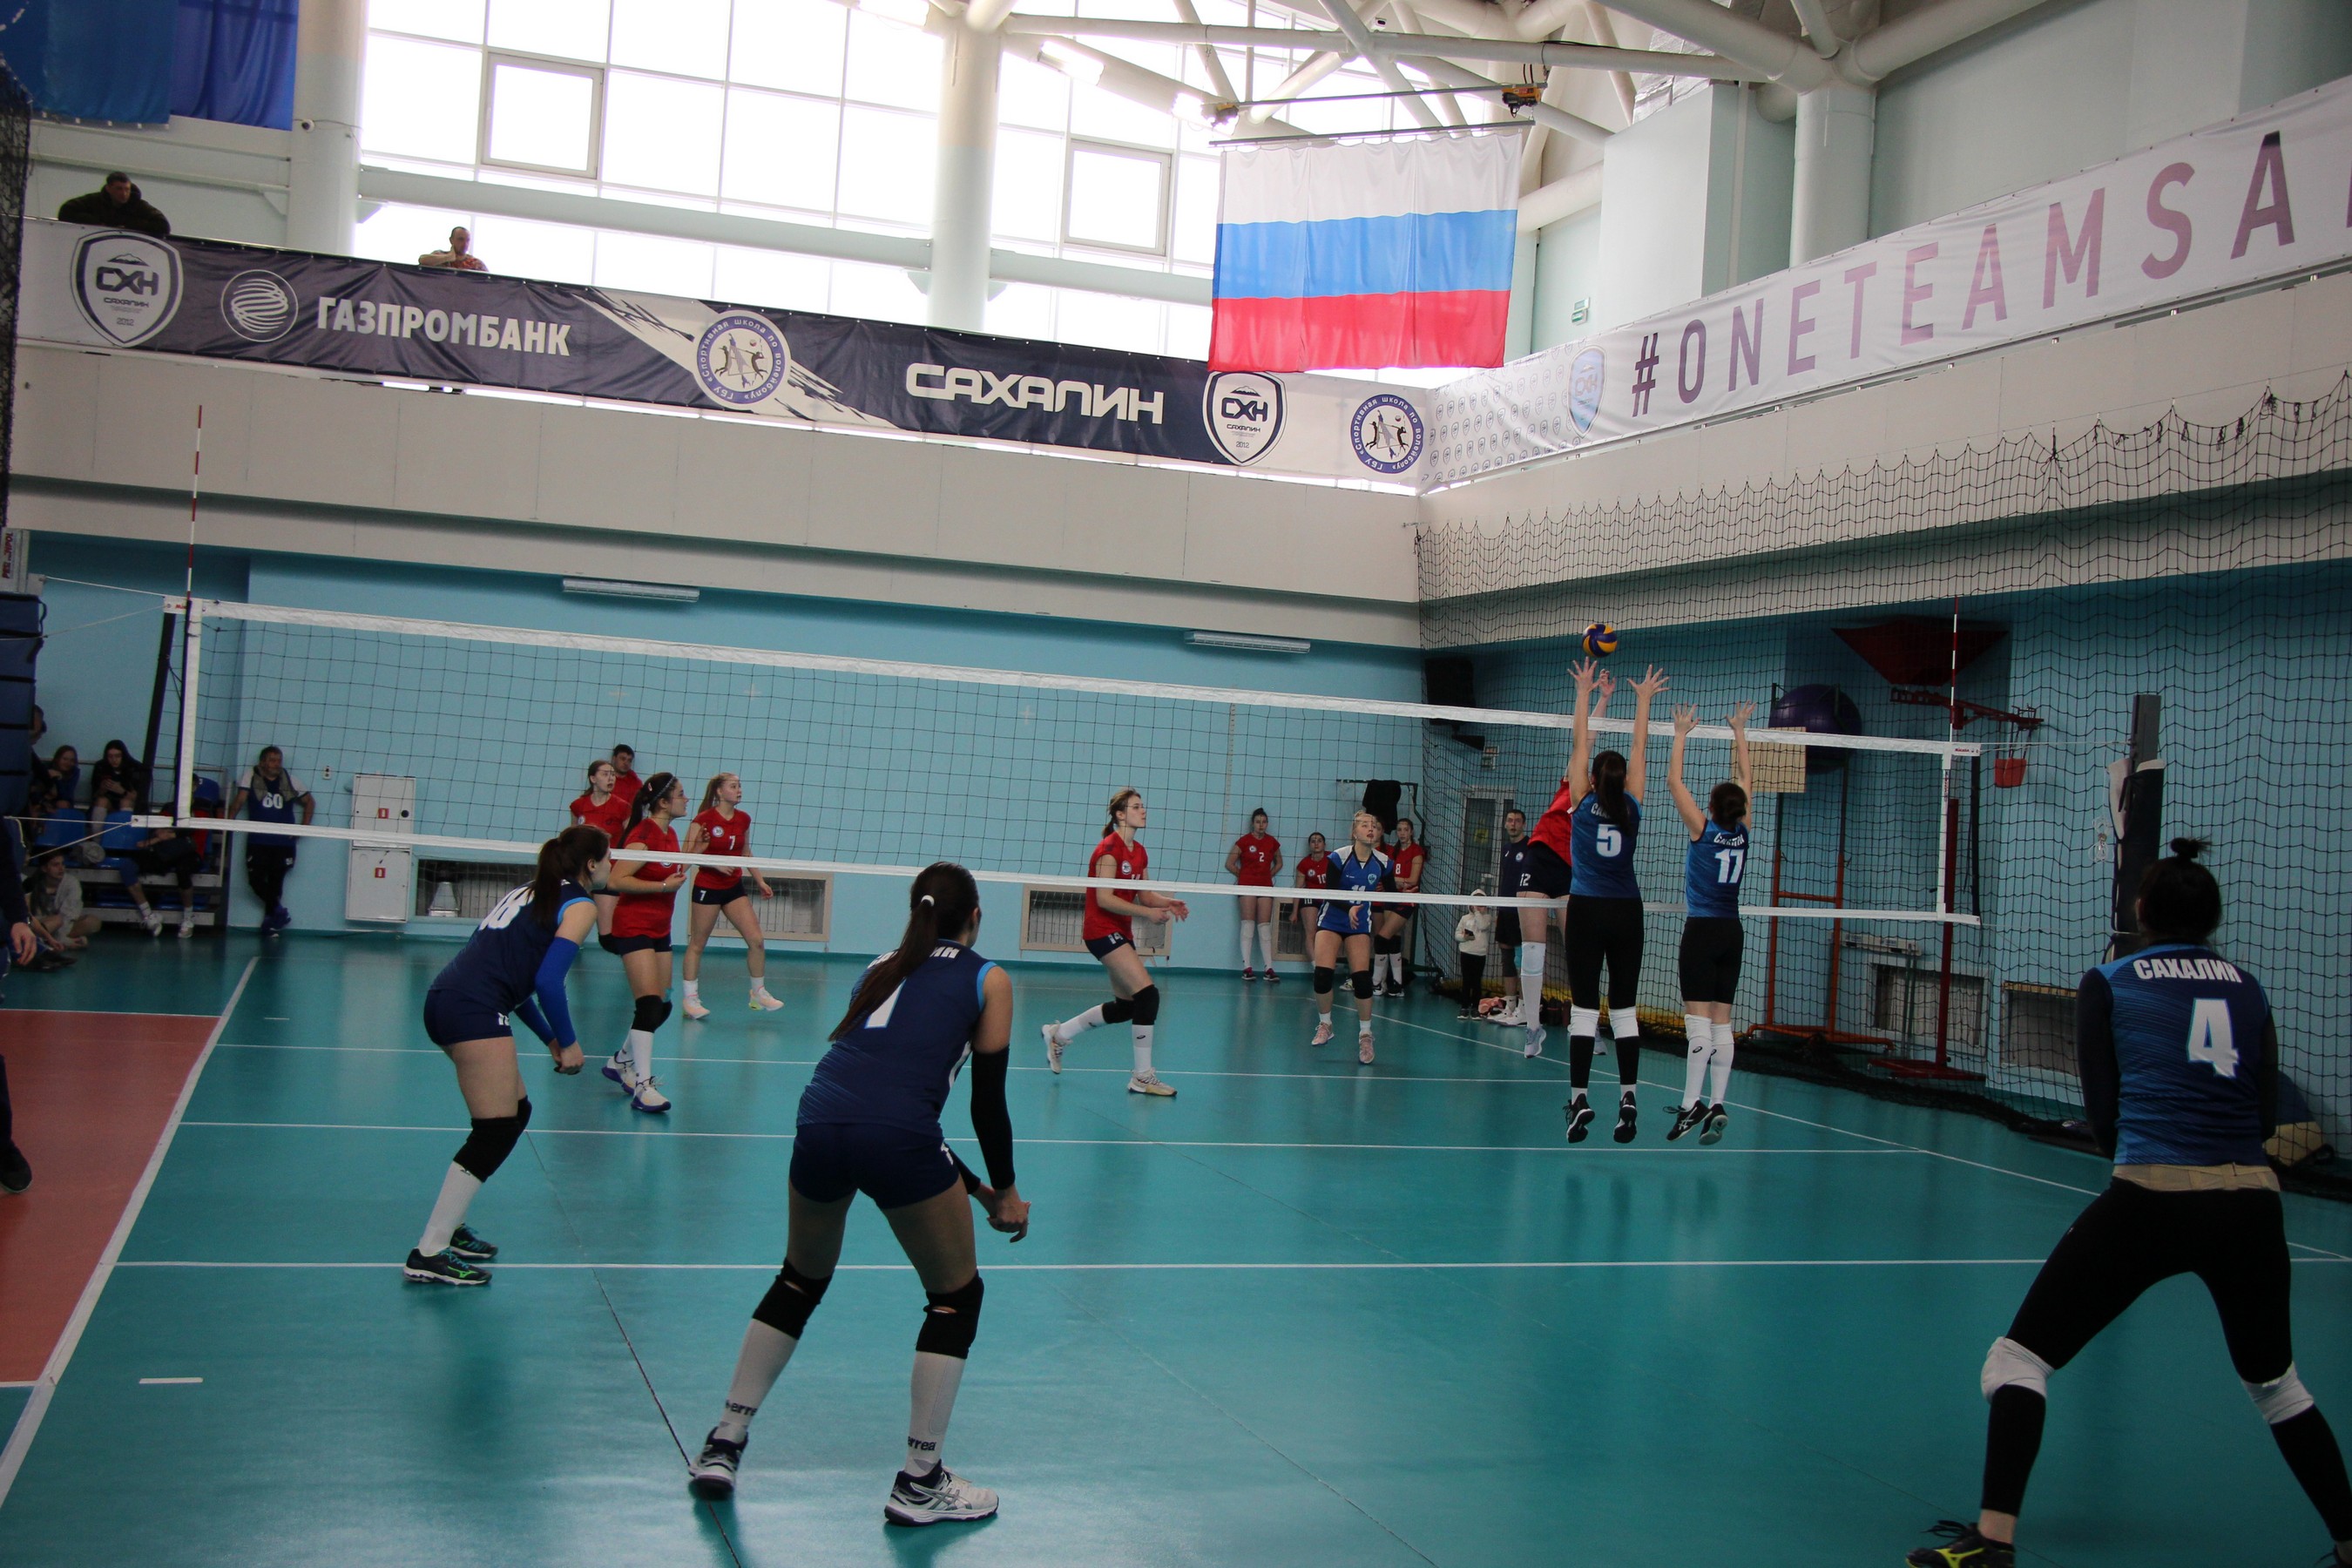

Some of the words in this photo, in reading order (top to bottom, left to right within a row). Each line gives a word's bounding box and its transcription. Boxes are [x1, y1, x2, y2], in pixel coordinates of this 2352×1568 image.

[1632, 131, 2352, 417] #ONETEAMSA
[116, 317, 135, 327] 2012
[317, 296, 571, 356] ГАЗПРОМБАНК
[906, 362, 1164, 424] САХАЛИН
[1227, 423, 1260, 433] САХАЛИН
[262, 793, 283, 809] 60
[729, 835, 736, 850] 7
[1596, 823, 1622, 858] 5
[1259, 852, 1265, 862] 2
[1396, 863, 1402, 875] 8
[1714, 848, 1745, 883] 17
[1519, 873, 1531, 886] 12
[700, 890, 706, 902] 7
[1108, 931, 1124, 945] 14
[2133, 958, 2242, 983] САХАЛИН
[2186, 997, 2240, 1078] 4
